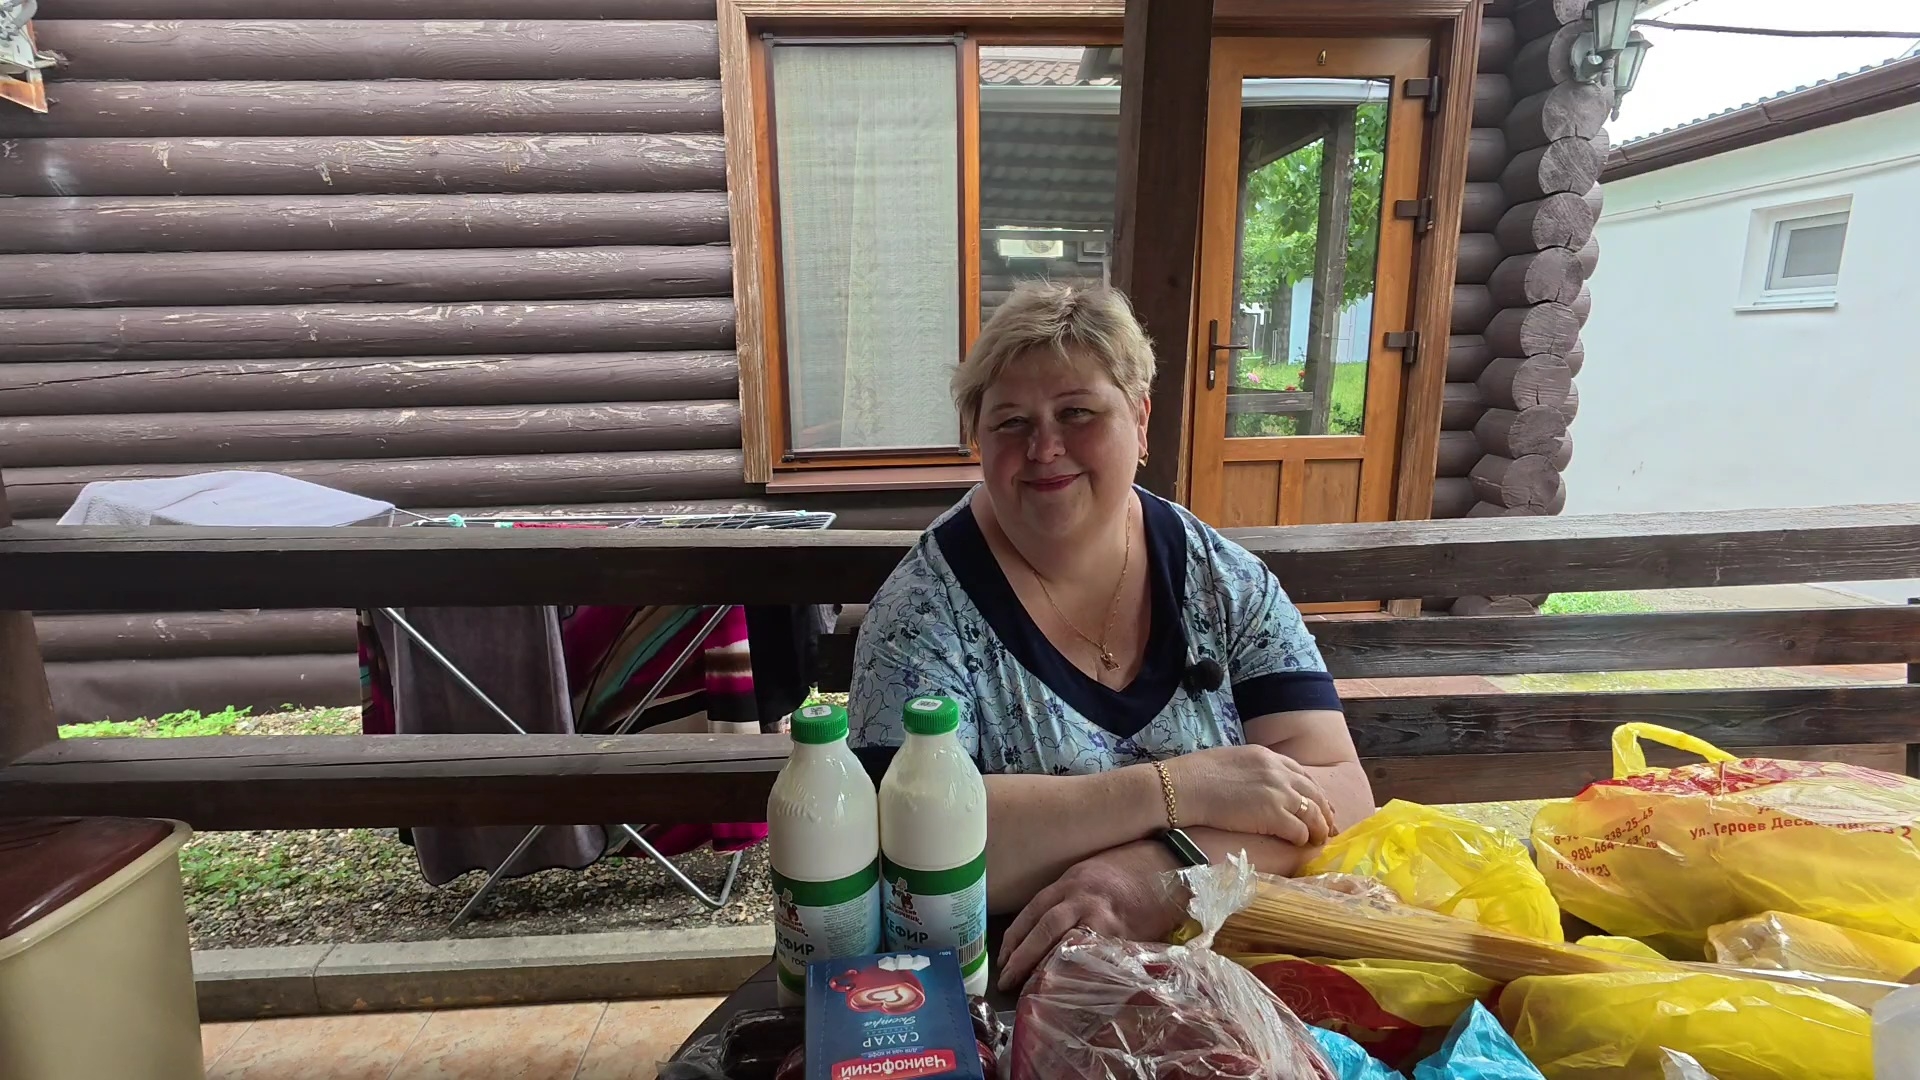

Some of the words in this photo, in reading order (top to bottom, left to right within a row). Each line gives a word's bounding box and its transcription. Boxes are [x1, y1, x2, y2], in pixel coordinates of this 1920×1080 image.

[1316, 49, 1327, 65] 4
[1689, 826, 1711, 841] ул.
[1713, 821, 1767, 839] Героев
[1901, 825, 1913, 840] 2
[777, 931, 815, 956] ЕФИР
[863, 1015, 916, 1028] Экстра
[862, 1031, 919, 1048] САХАР
[840, 1054, 947, 1080] Чайкофский
